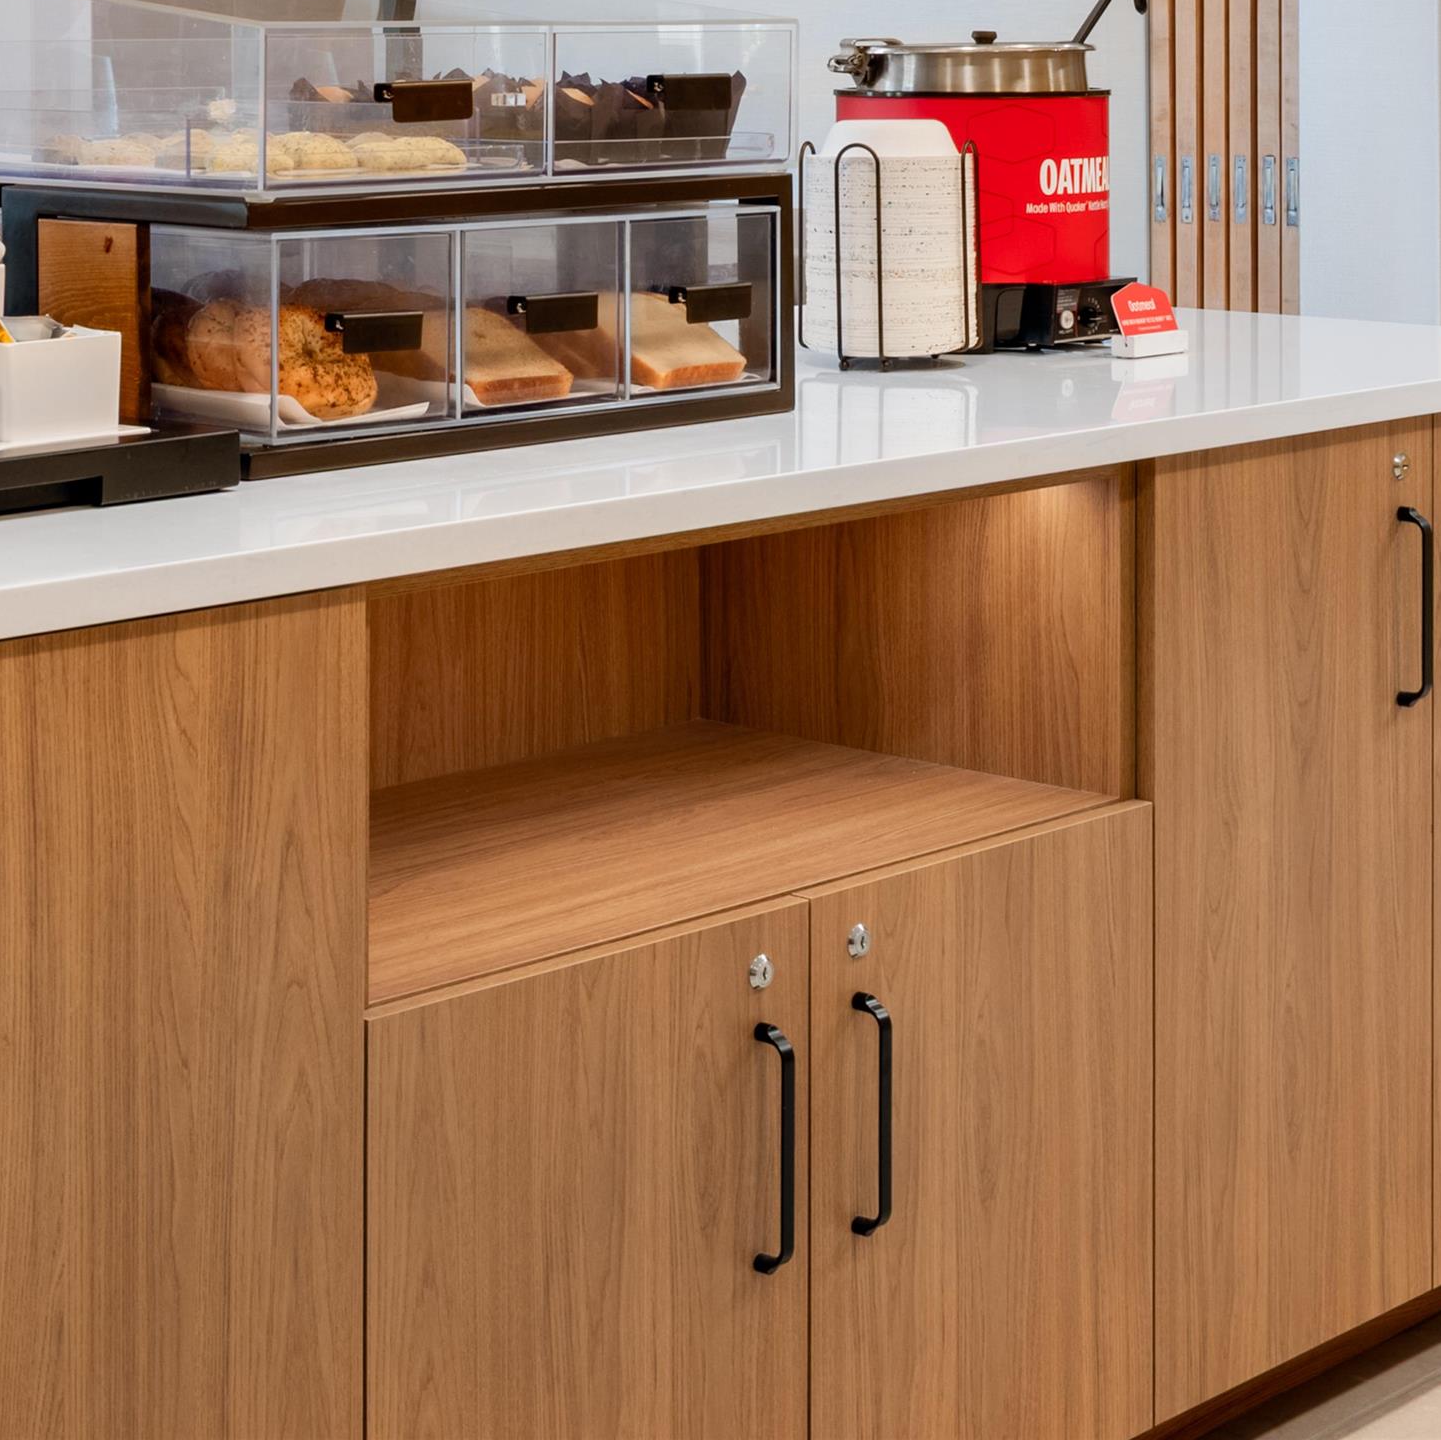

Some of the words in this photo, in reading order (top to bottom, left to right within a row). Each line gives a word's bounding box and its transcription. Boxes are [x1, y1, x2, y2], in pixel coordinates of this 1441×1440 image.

[1039, 156, 1109, 196] OATMEA
[1025, 202, 1048, 214] Made
[1048, 201, 1065, 213] With
